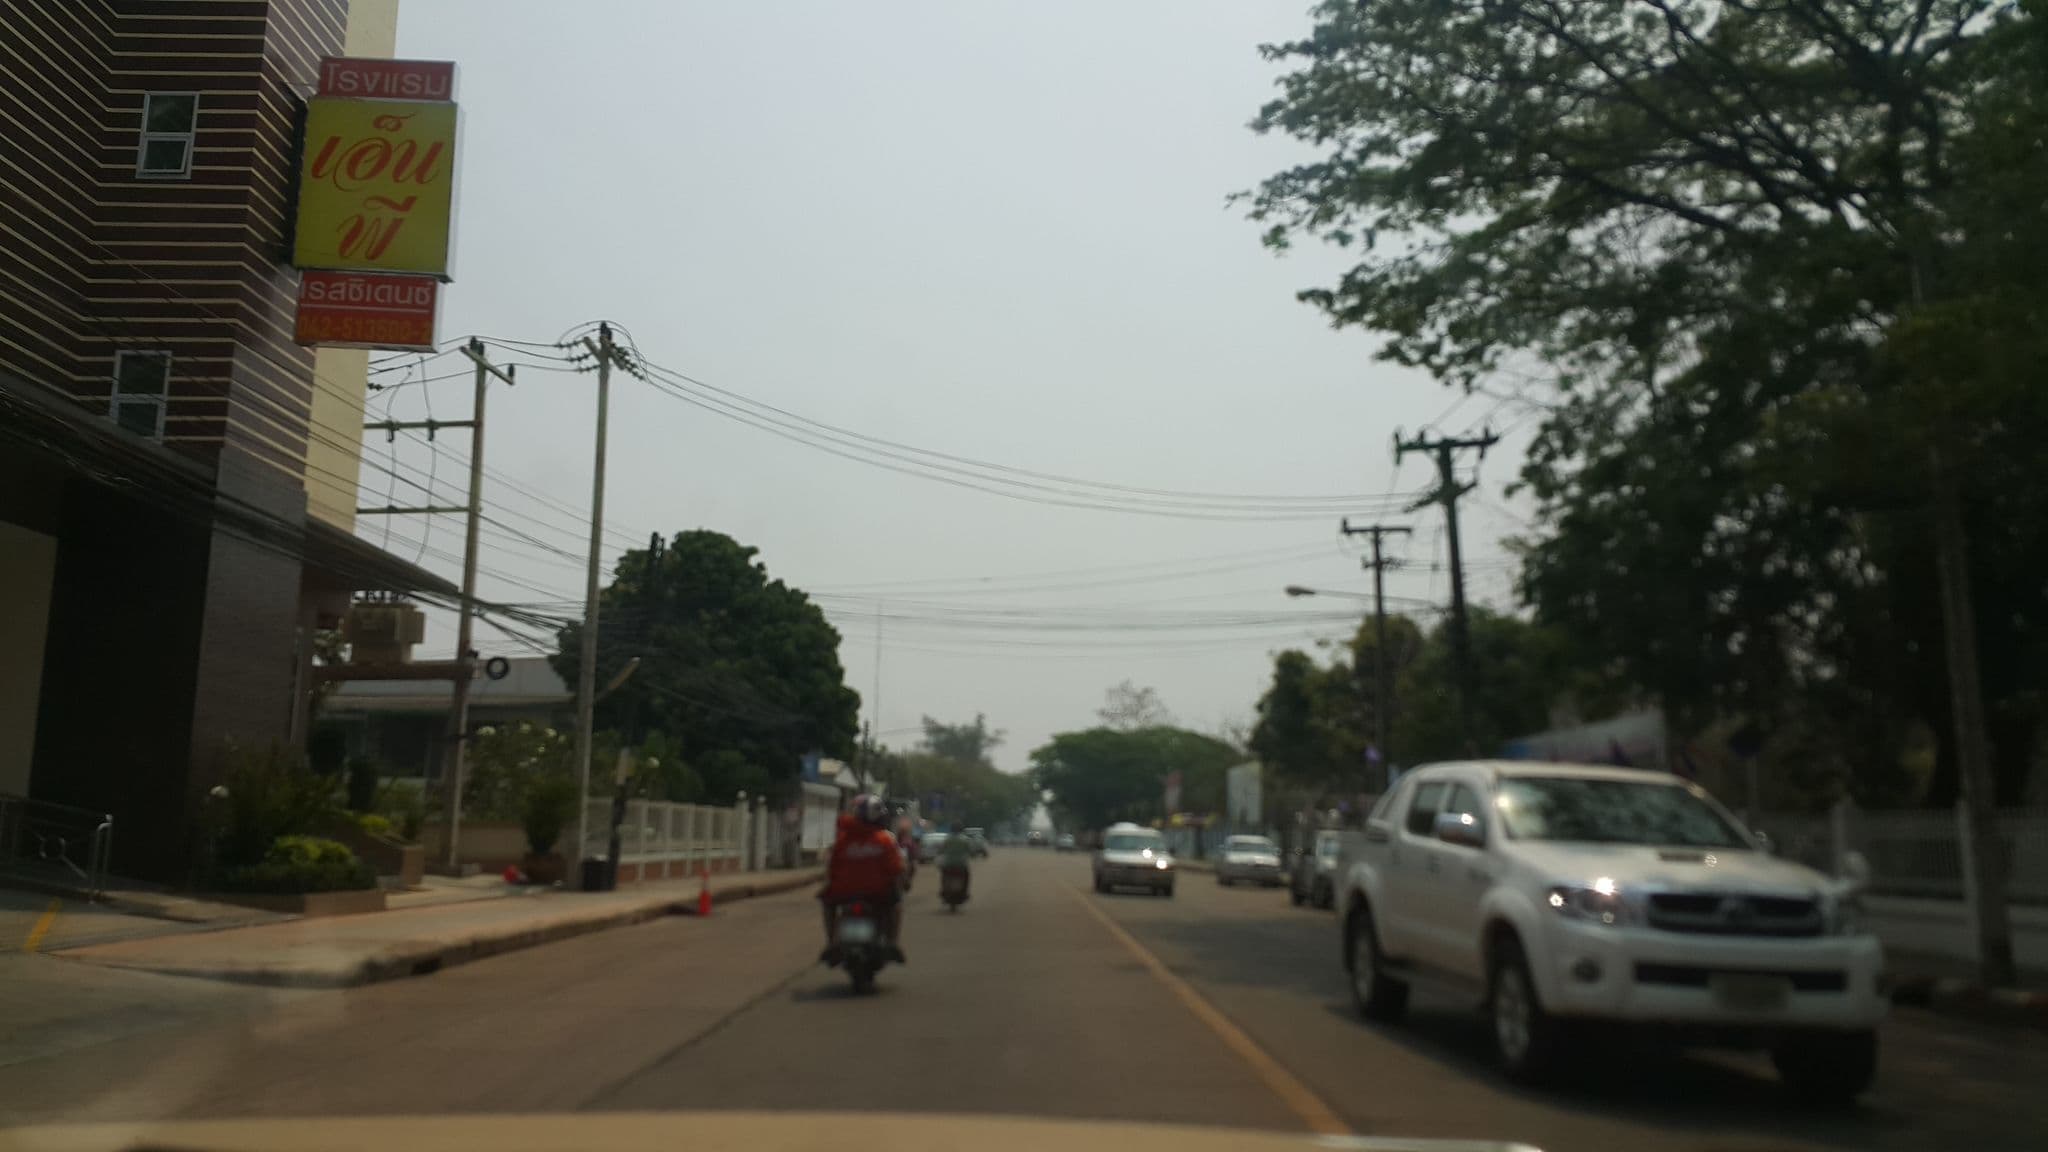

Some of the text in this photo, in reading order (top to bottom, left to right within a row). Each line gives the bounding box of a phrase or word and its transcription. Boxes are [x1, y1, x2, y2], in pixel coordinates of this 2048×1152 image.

[324, 63, 448, 95] โรงแรม
[311, 111, 446, 192] เอ็น
[336, 195, 418, 260] พี
